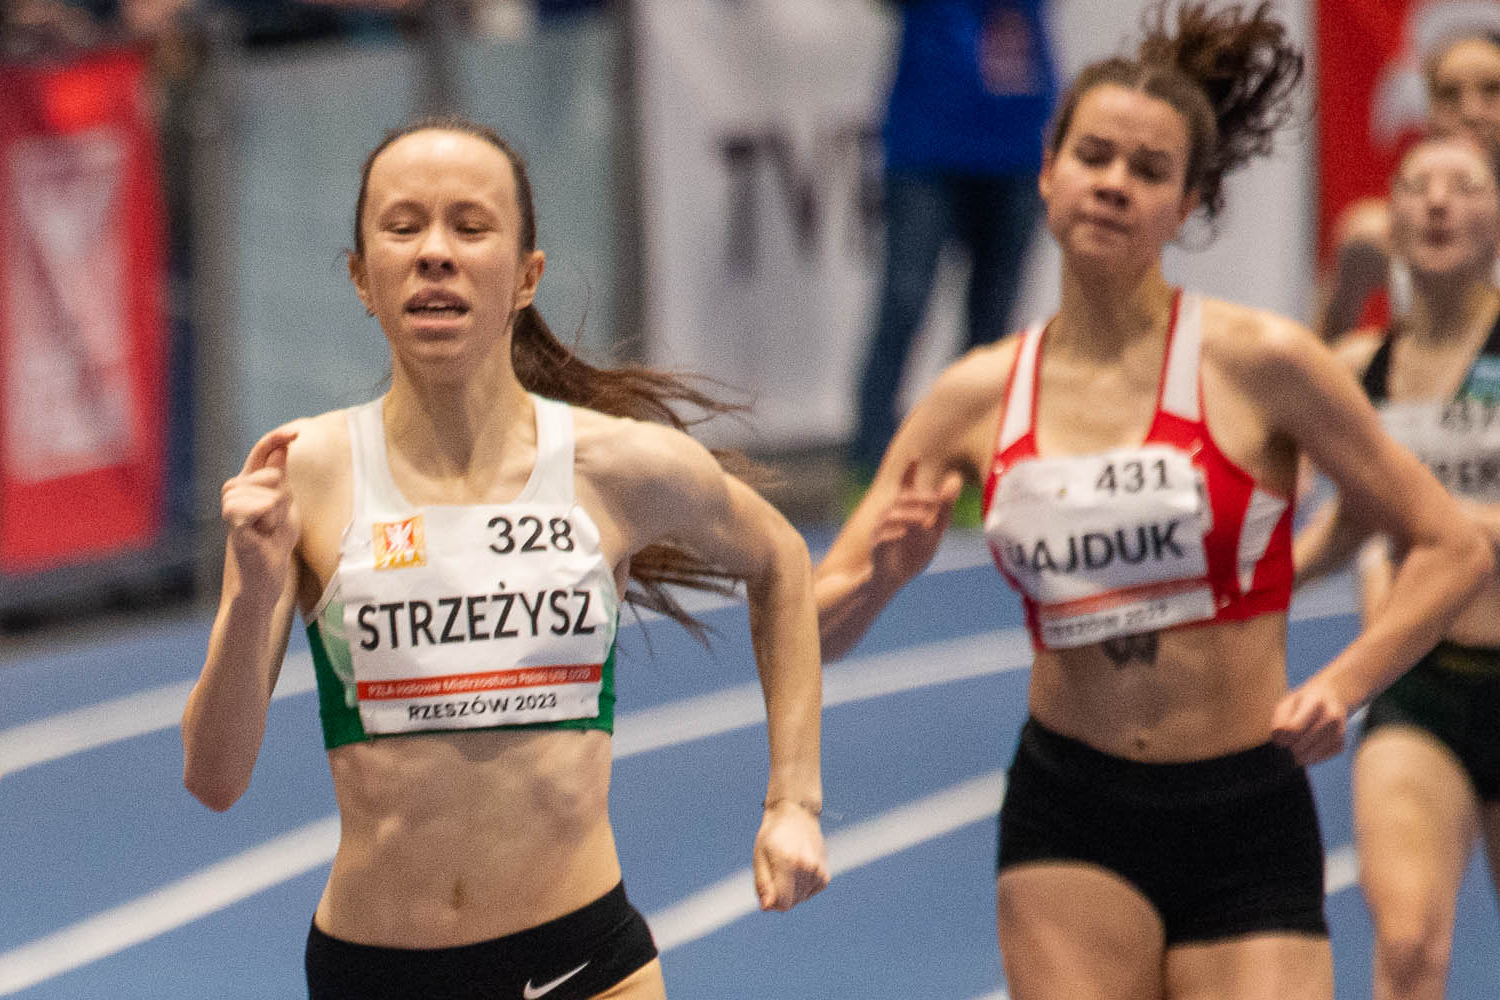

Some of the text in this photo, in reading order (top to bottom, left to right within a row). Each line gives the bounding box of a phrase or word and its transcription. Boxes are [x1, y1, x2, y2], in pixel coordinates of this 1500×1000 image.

[1095, 459, 1173, 494] 431
[487, 516, 574, 555] 328
[357, 581, 597, 651] STRZEŻYSZ
[408, 692, 557, 721] RZESZÓW 2023
